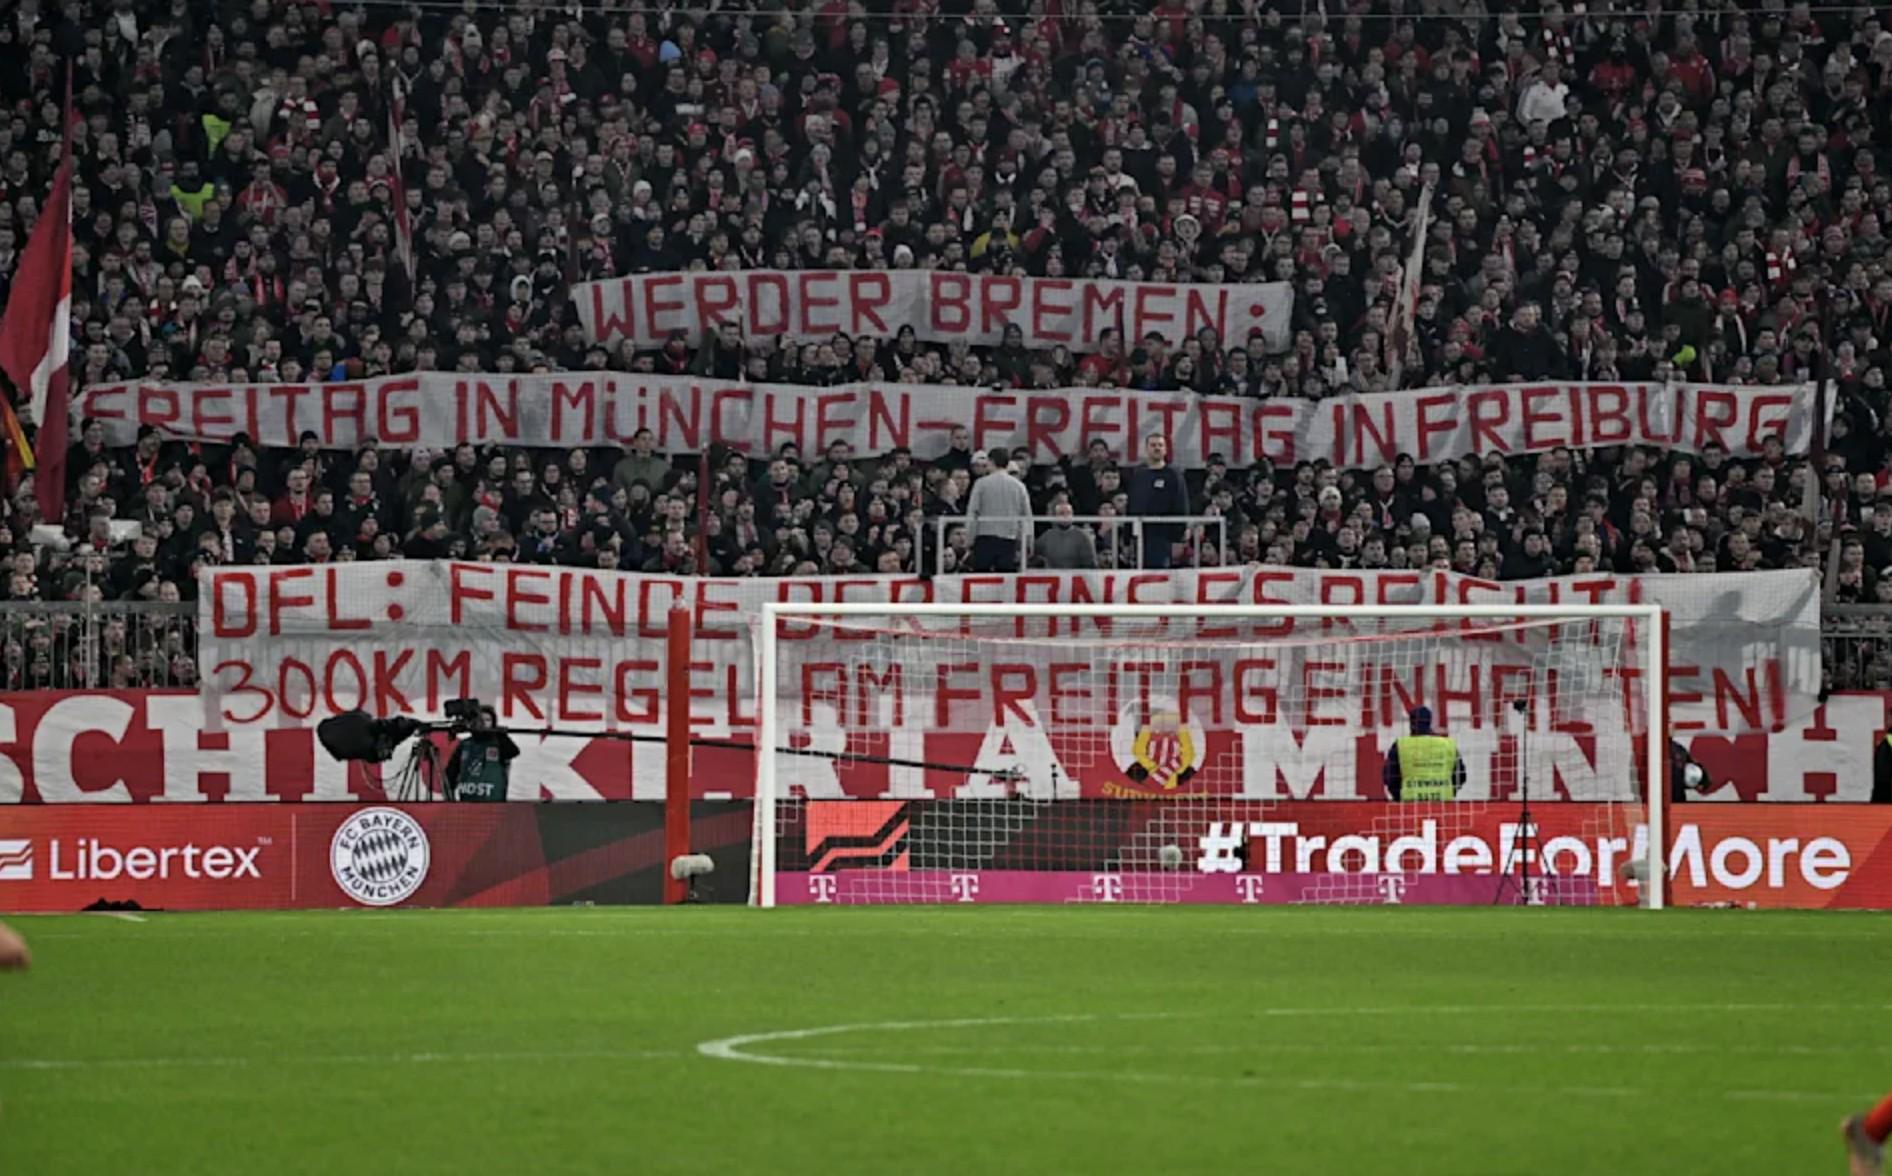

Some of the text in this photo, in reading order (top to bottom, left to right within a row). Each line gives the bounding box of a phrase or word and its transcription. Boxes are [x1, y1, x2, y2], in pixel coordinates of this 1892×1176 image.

[592, 272, 891, 341] WERDER
[82, 378, 420, 446] FREITAG
[454, 379, 520, 443] IN
[1332, 400, 1398, 466] IN
[1415, 384, 1793, 462] FREIBURG
[450, 563, 739, 640] FEINDE
[776, 579, 935, 640] DER
[1196, 572, 1295, 638] ES
[212, 648, 1785, 733] 300KM REGEL AM FREITAG EINHALTEN!
[49, 839, 262, 880] Libertex
[340, 815, 420, 850] FC BAYERN
[1197, 819, 1850, 890] #TradeForMore
